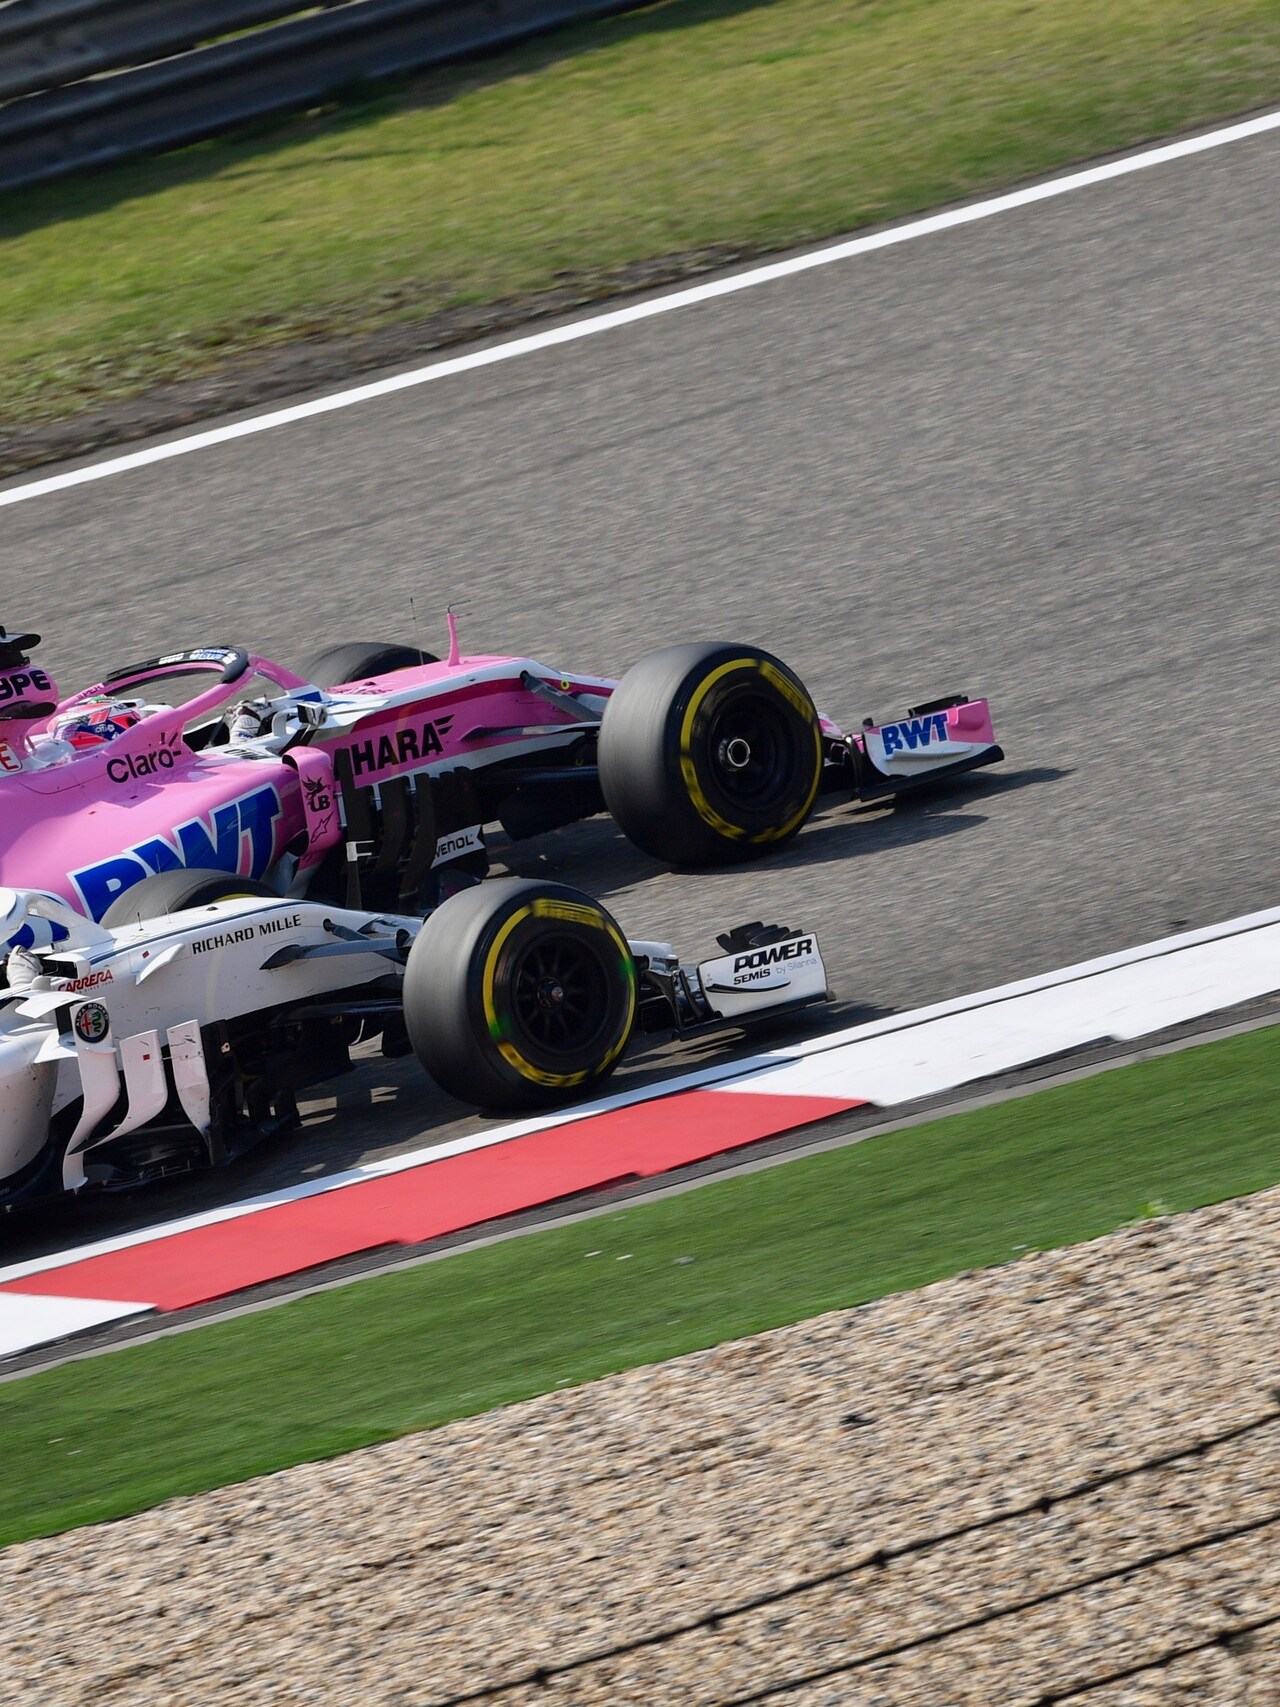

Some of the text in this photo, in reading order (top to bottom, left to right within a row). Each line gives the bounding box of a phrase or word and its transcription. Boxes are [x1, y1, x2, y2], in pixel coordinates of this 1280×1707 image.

[881, 712, 949, 756] BWT
[106, 738, 180, 784] Claro
[191, 913, 302, 956] RICHARD MILLE
[733, 938, 813, 974] POWER
[787, 957, 818, 972] Silanna
[57, 969, 113, 993] CARRERA
